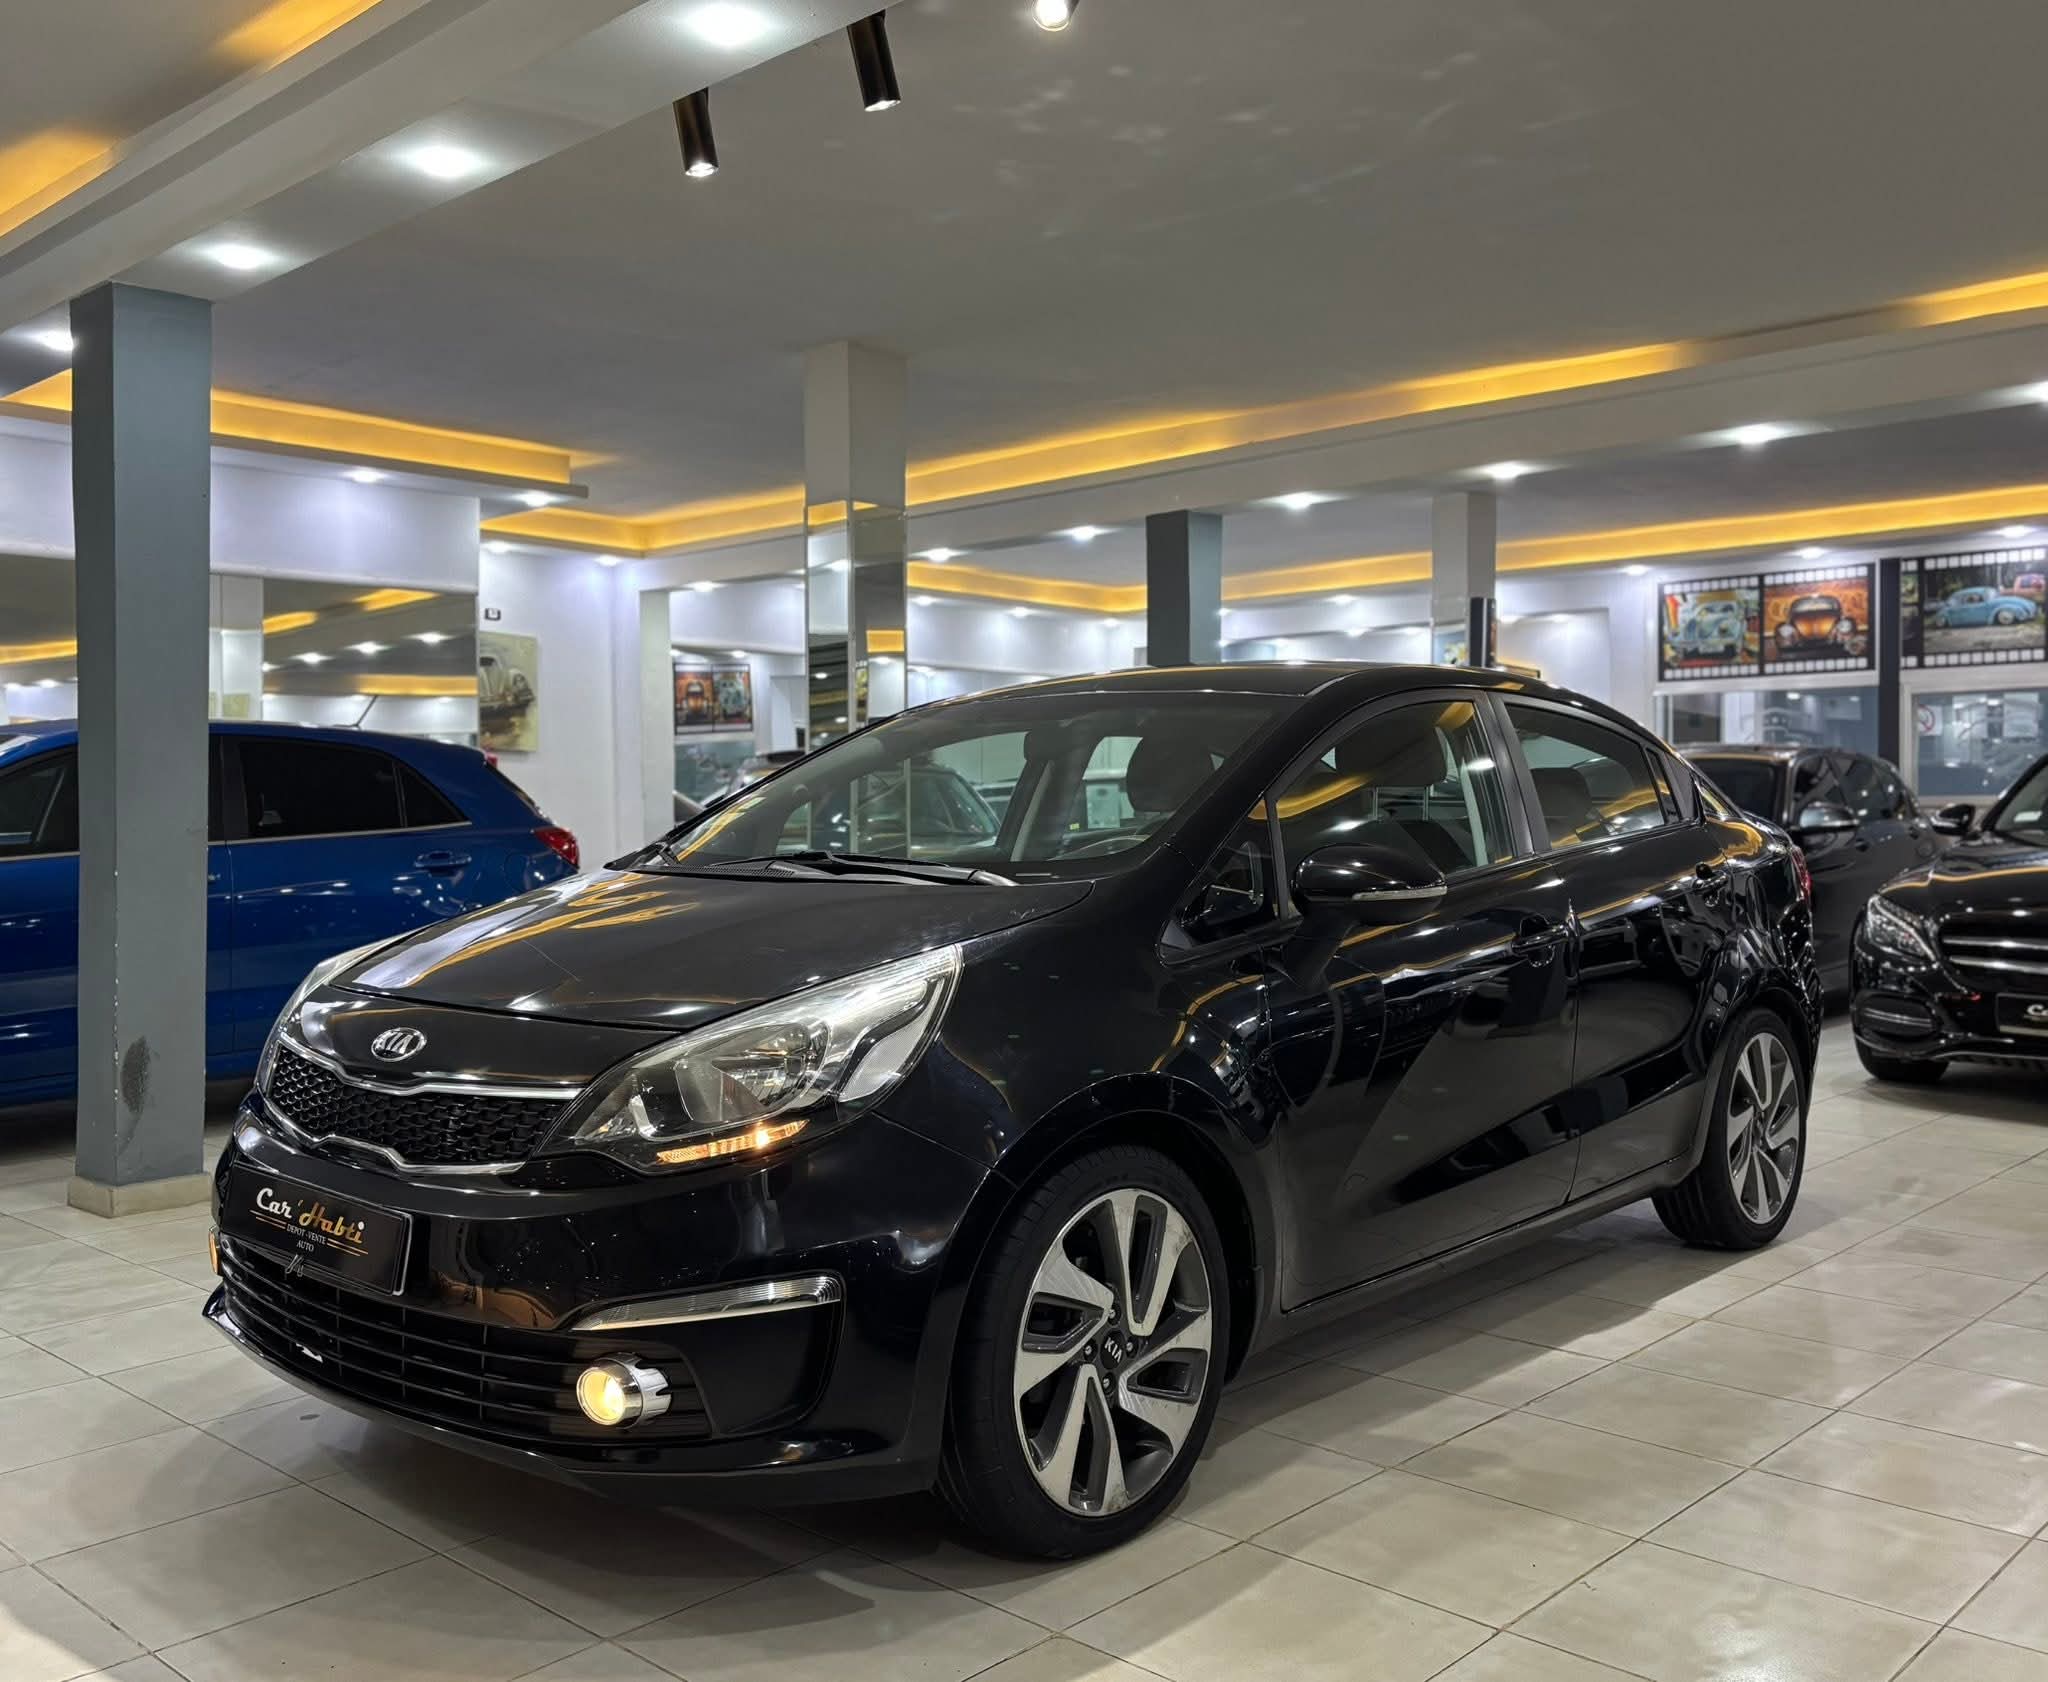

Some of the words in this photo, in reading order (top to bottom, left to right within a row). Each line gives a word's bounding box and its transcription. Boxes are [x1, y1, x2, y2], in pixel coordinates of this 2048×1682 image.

[374, 1030, 415, 1055] KIA
[296, 1239, 315, 1253] AUTO
[1104, 1336, 1123, 1363] KIA
